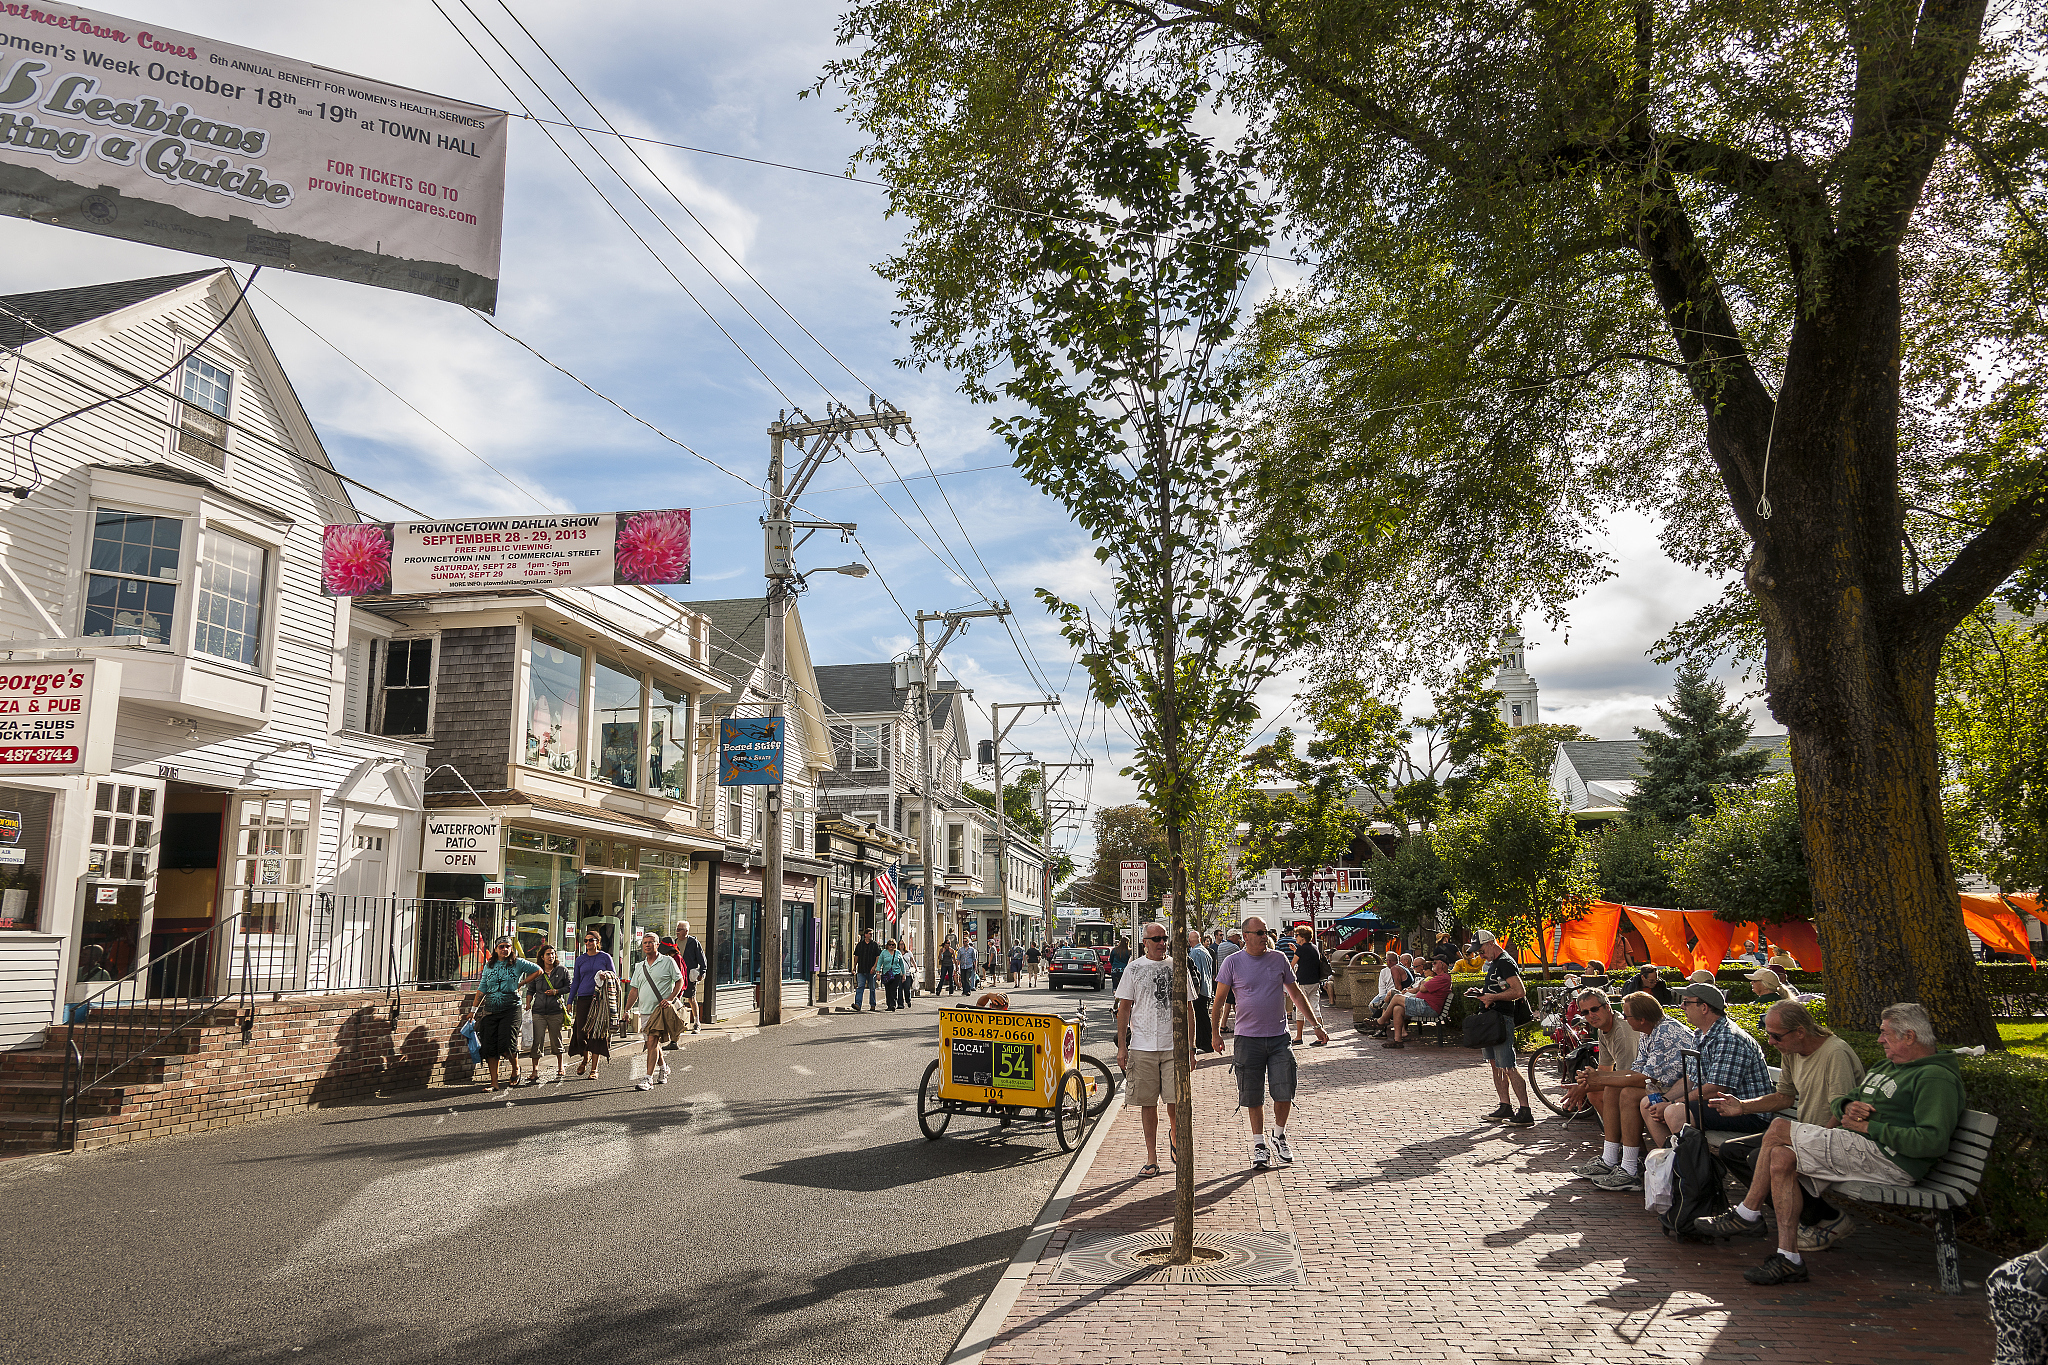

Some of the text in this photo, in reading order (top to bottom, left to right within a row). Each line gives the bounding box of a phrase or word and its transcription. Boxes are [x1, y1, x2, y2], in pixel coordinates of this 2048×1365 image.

[137, 31, 198, 59] Cares
[209, 53, 485, 130] 6th ANNUAL BENEFIT FOR WOMEN'S HEALTH SERVICES
[82, 49, 141, 77] Week
[147, 62, 245, 100] October
[254, 87, 297, 109] 18th
[298, 107, 313, 117] and
[316, 102, 357, 123] 19th
[360, 118, 374, 131] at
[378, 119, 431, 145] TOWN
[437, 133, 481, 159] HALL
[44, 76, 265, 154] Lesbians
[101, 136, 136, 161] a
[145, 137, 293, 204] Quiche
[327, 159, 459, 202] FOR TICKETS GO TO
[308, 176, 477, 226] provincetowncares.com
[409, 517, 600, 534] PROVINCETOWN DAHLIA SHOW
[422, 533, 501, 546] SEPTEMBER
[505, 532, 520, 542] 28
[532, 531, 552, 542] 29,
[555, 529, 587, 540] 2013
[404, 555, 473, 564] PROVINCETOWN
[508, 552, 565, 560] COMMERCIAL
[434, 564, 480, 572] SATURDAY,
[431, 572, 466, 580] SUNDAY,
[28, 699, 40, 713] &
[47, 699, 81, 712] PUB
[34, 720, 75, 729] SUBS
[0, 731, 65, 740] CKTAILS
[722, 741, 781, 752] Board Stiff
[159, 765, 179, 779] 275
[429, 823, 497, 835] WATERFRONT
[446, 837, 476, 848] PATIO
[444, 854, 476, 866] OPEN
[487, 886, 501, 894] sale
[940, 1012, 1051, 1028] P-TOWN PEDICABS
[952, 1027, 1034, 1041] 508-487-0660
[953, 1043, 985, 1053] LOCAL
[1002, 1045, 1025, 1054] SALON
[999, 1053, 1029, 1078] 54
[984, 1088, 1003, 1099] 104
